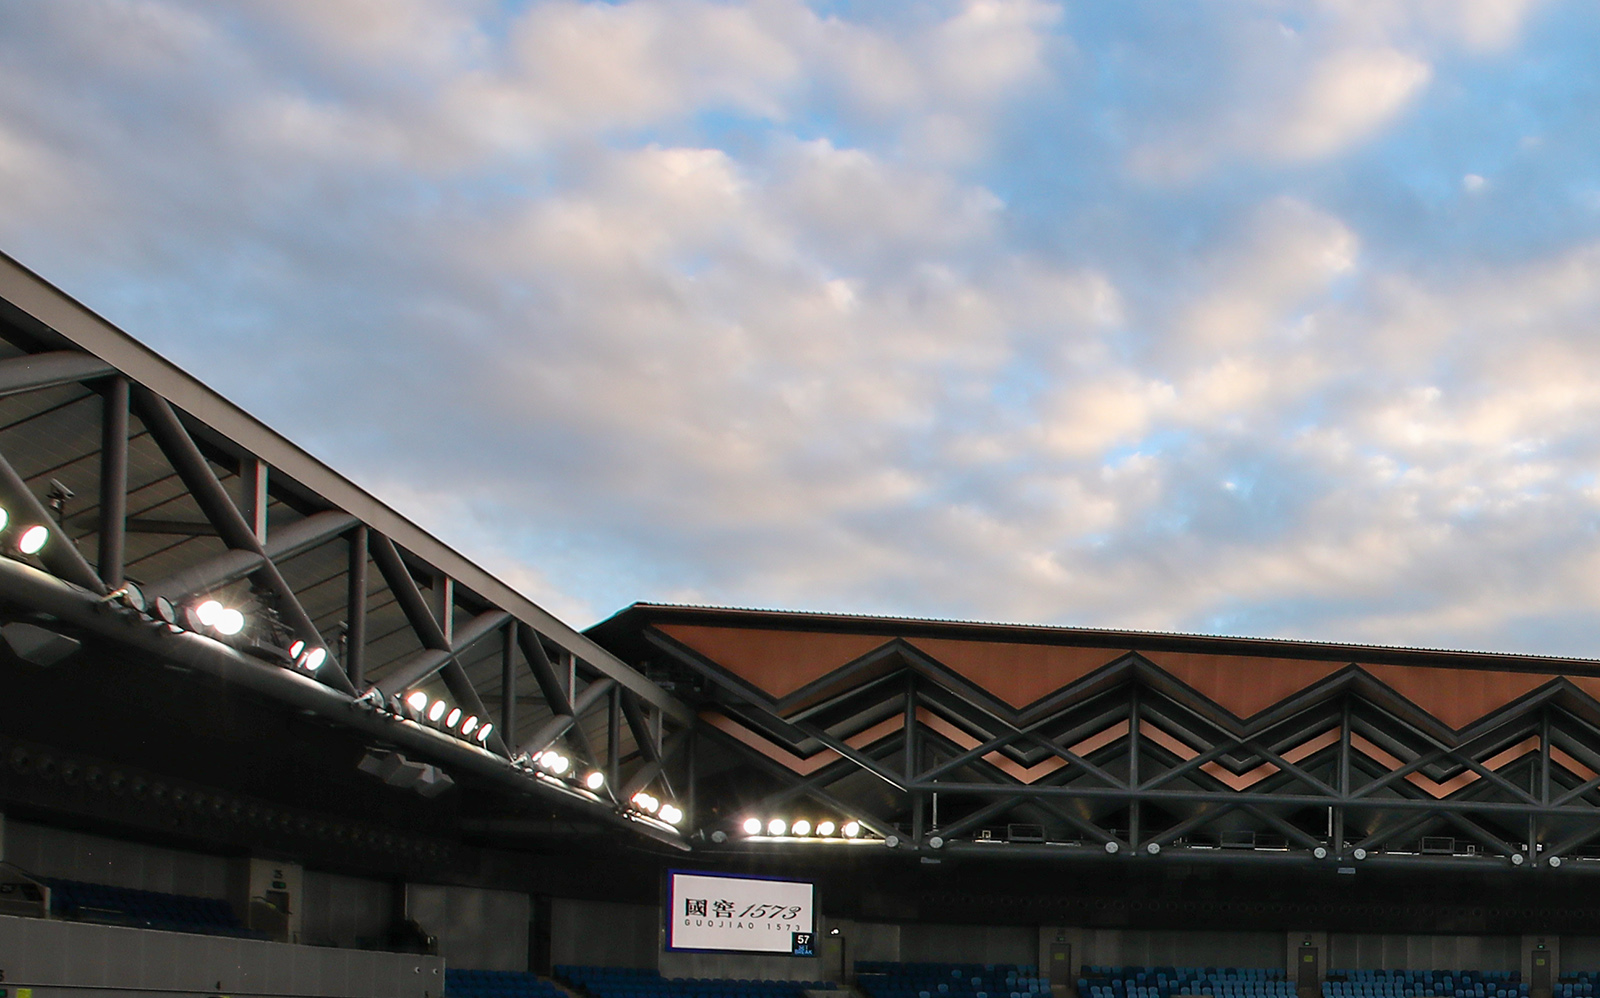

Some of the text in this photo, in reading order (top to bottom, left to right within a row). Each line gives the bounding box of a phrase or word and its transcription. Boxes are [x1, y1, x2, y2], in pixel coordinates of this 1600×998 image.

[685, 919, 801, 932] GUOJIAO 1573
[797, 935, 810, 945] 57
